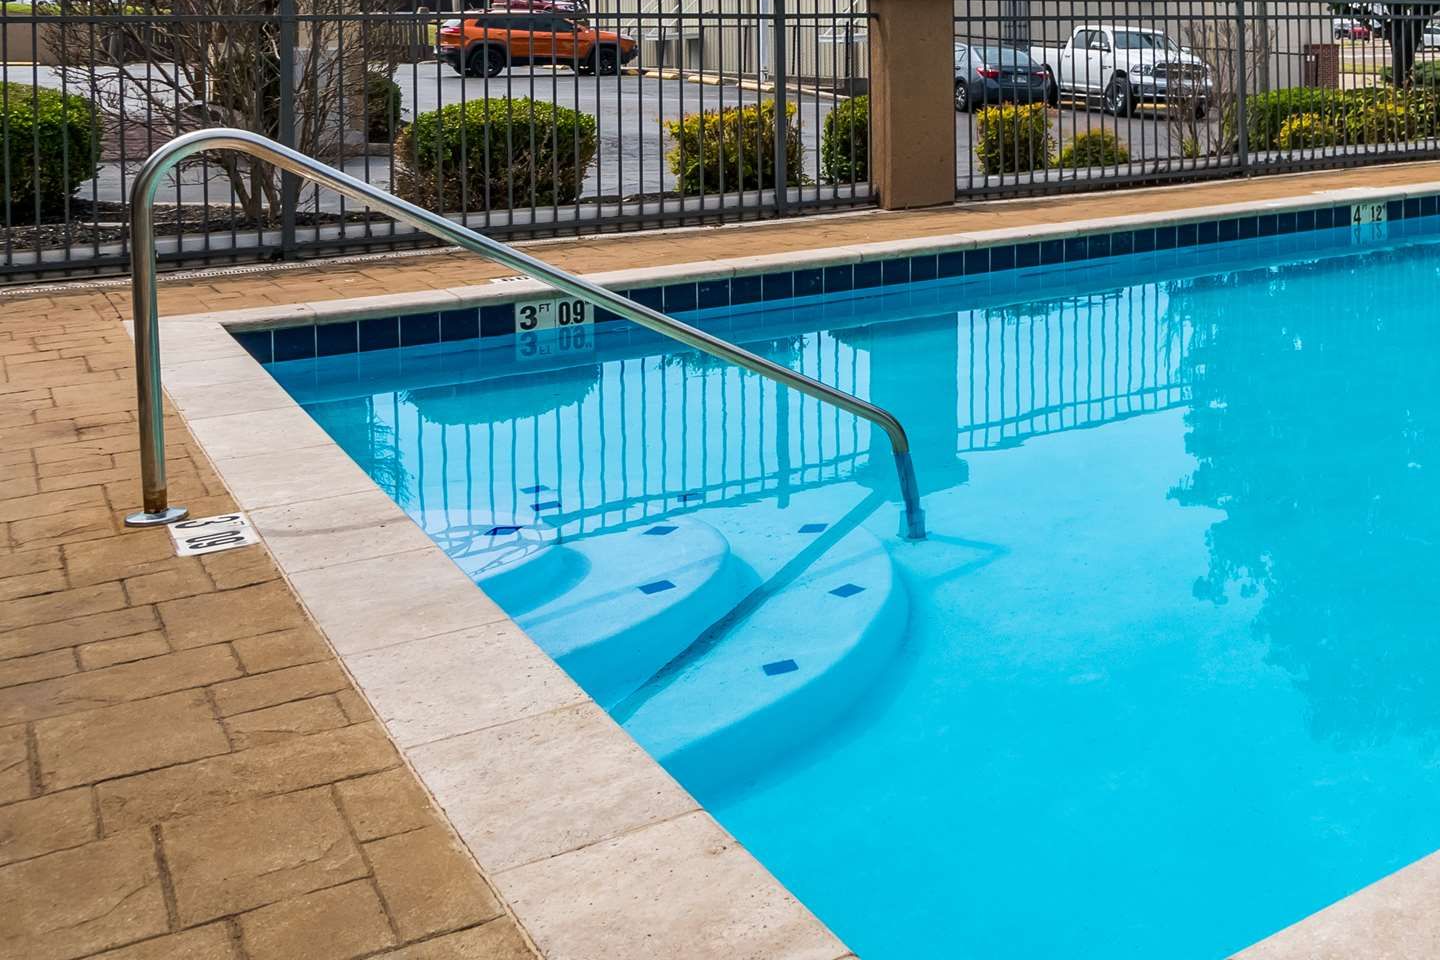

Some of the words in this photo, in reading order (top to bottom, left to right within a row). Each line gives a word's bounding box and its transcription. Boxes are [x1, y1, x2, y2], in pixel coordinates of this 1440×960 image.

[1354, 205, 1361, 224] 4
[520, 305, 538, 330] 3
[538, 303, 552, 312] FT
